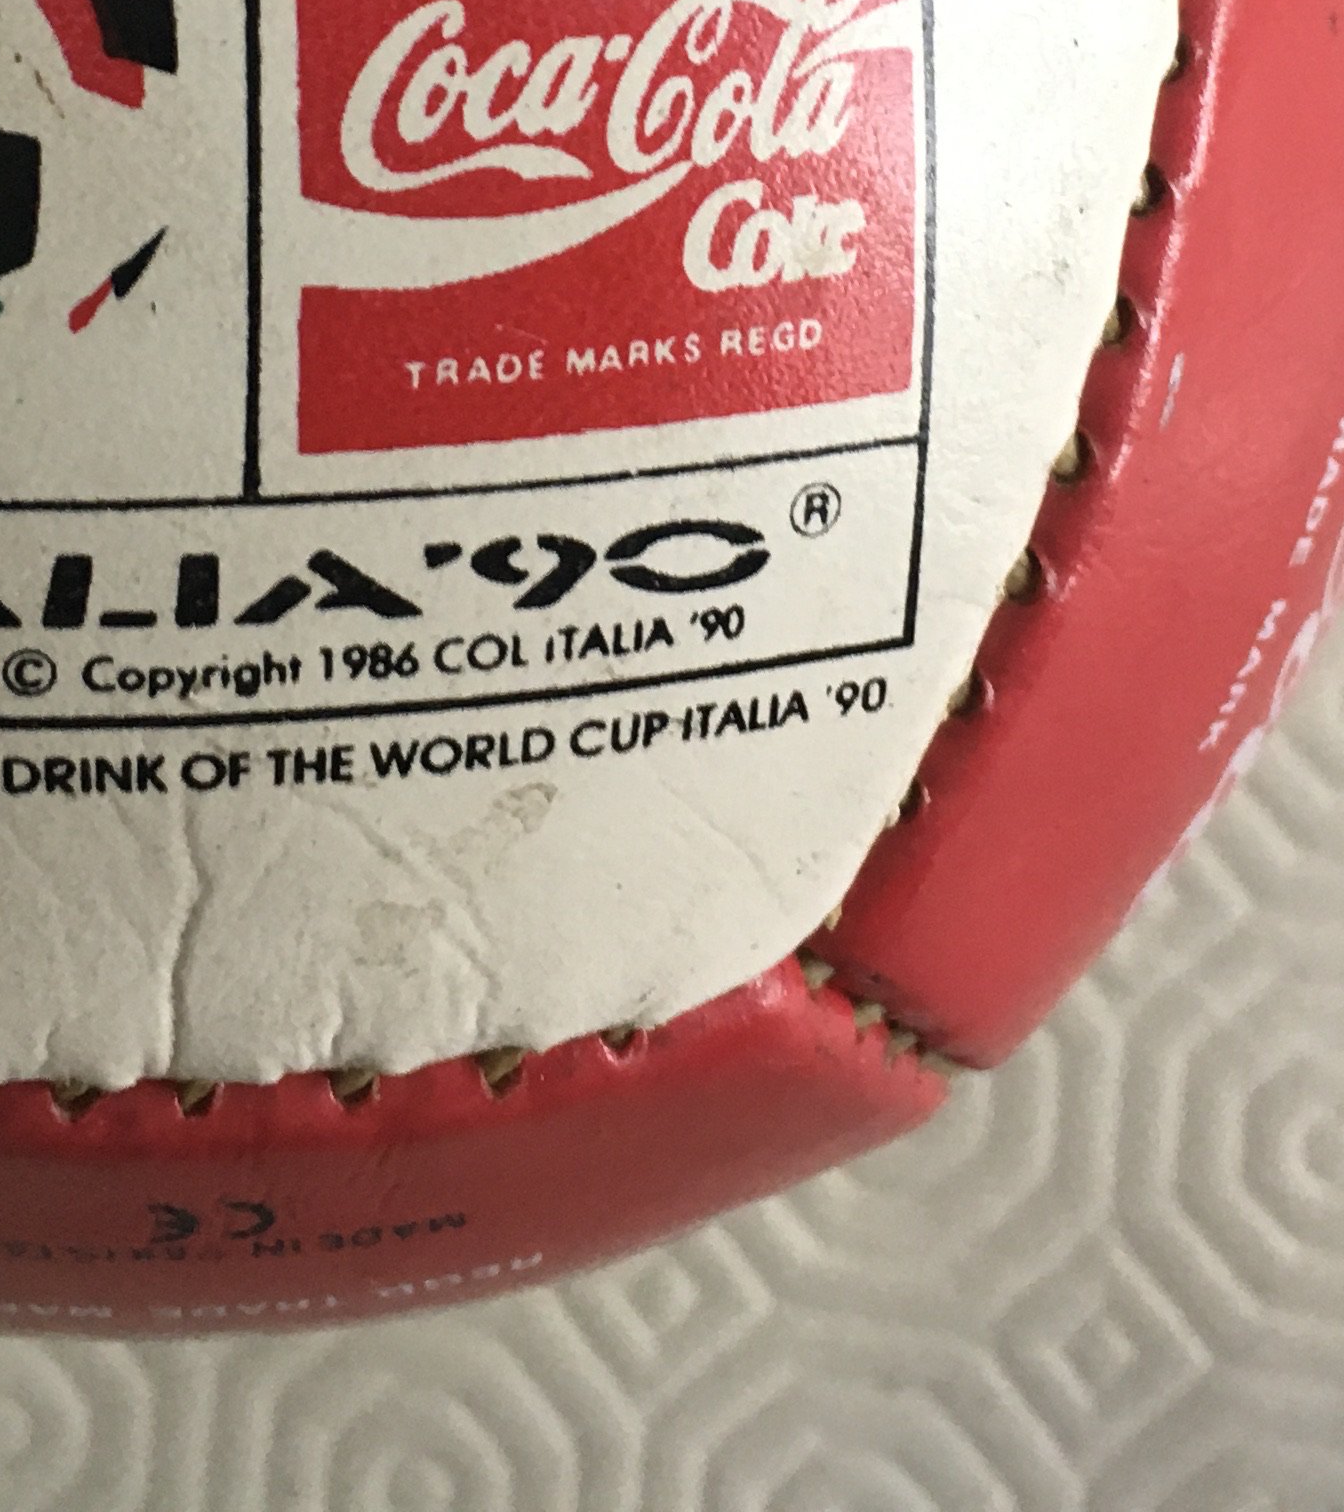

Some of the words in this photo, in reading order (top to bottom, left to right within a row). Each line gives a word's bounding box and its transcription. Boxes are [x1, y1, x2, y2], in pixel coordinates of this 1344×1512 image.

[405, 349, 544, 387] TRADE
[566, 334, 702, 374] MARKS
[81, 653, 303, 697] Copyright
[319, 642, 420, 680] 1986
[433, 633, 529, 675] COL
[544, 617, 675, 663] ITALIA
[1197, 598, 1288, 752] MARK
[2, 753, 167, 795] DRINK
[180, 750, 253, 793] OF
[266, 744, 355, 786] THE
[369, 725, 556, 778] WORLD
[569, 713, 669, 760] CUP
[681, 688, 810, 742] ITALIA
